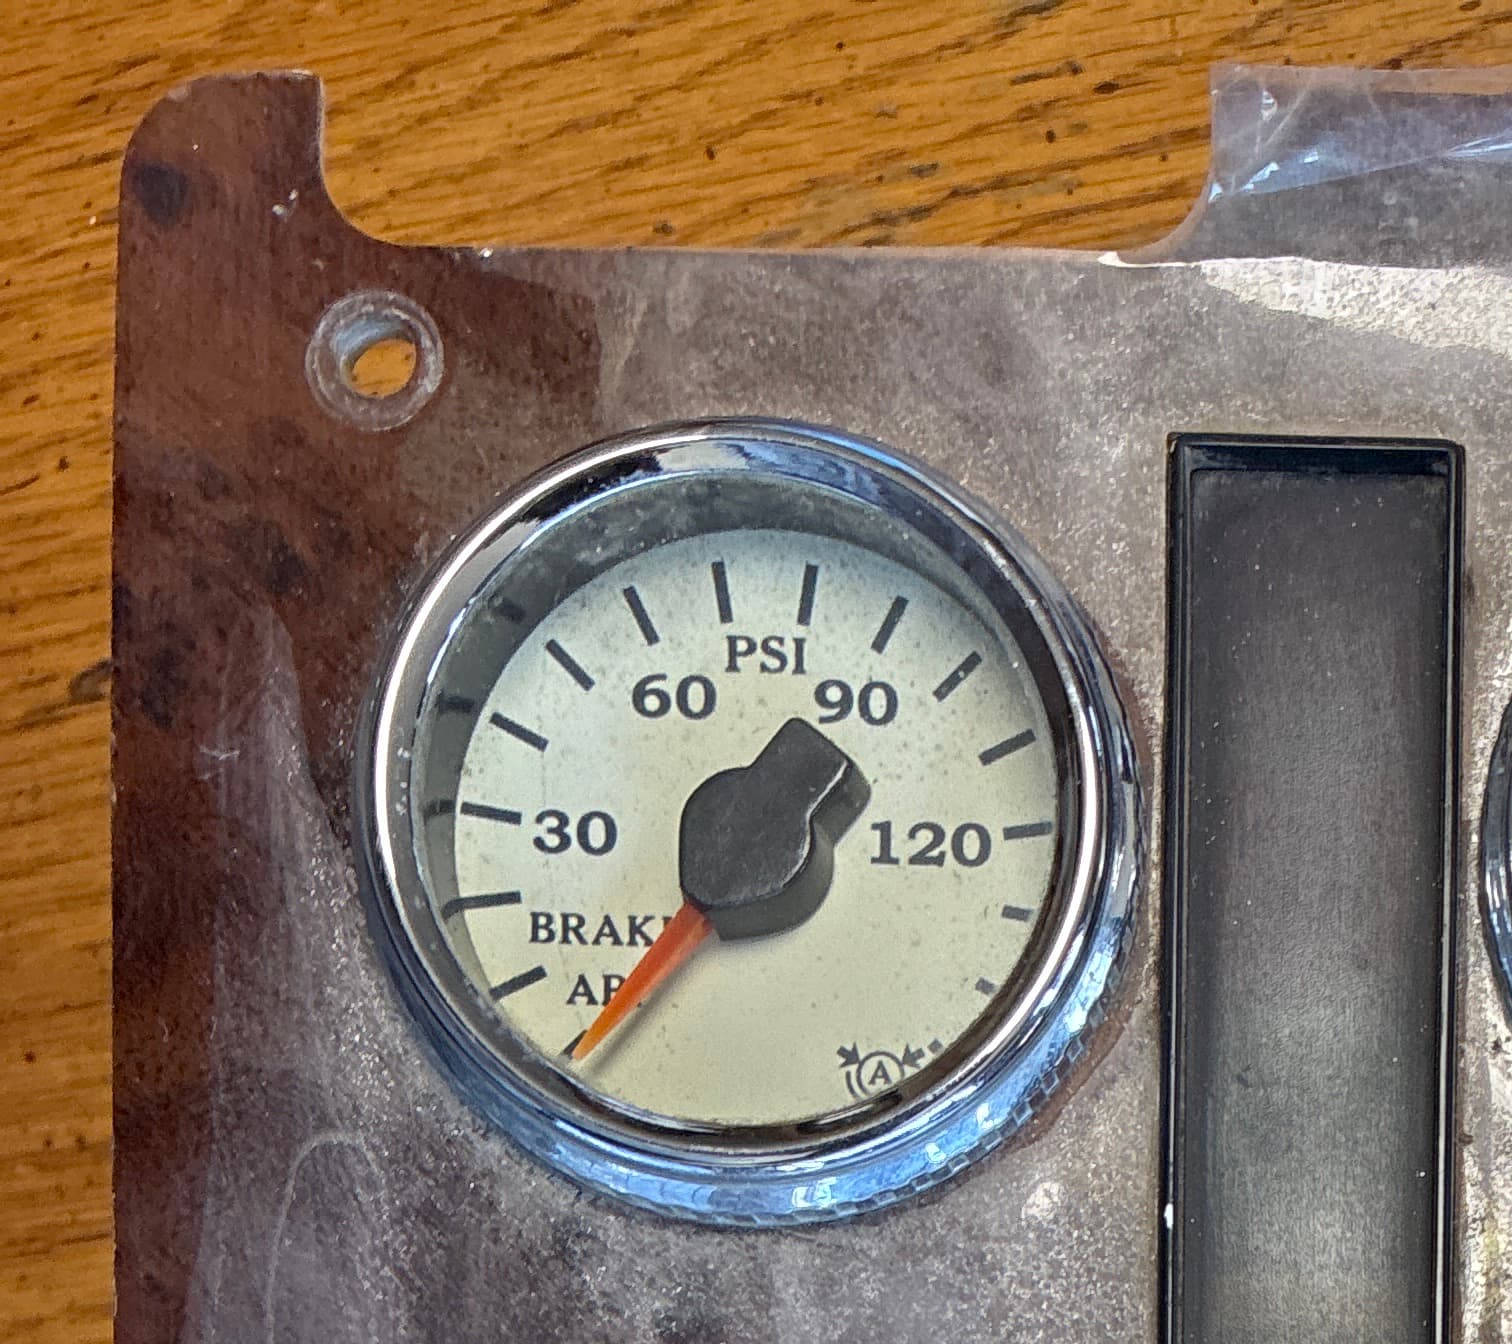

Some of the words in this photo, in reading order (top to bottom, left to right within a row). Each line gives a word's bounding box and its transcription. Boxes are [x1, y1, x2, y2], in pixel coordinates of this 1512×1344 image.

[724, 635, 808, 673] PSI
[631, 673, 717, 720] 60
[814, 679, 898, 726] 90
[532, 810, 618, 856] 30
[870, 819, 993, 868] 120
[529, 911, 676, 947] BRAK
